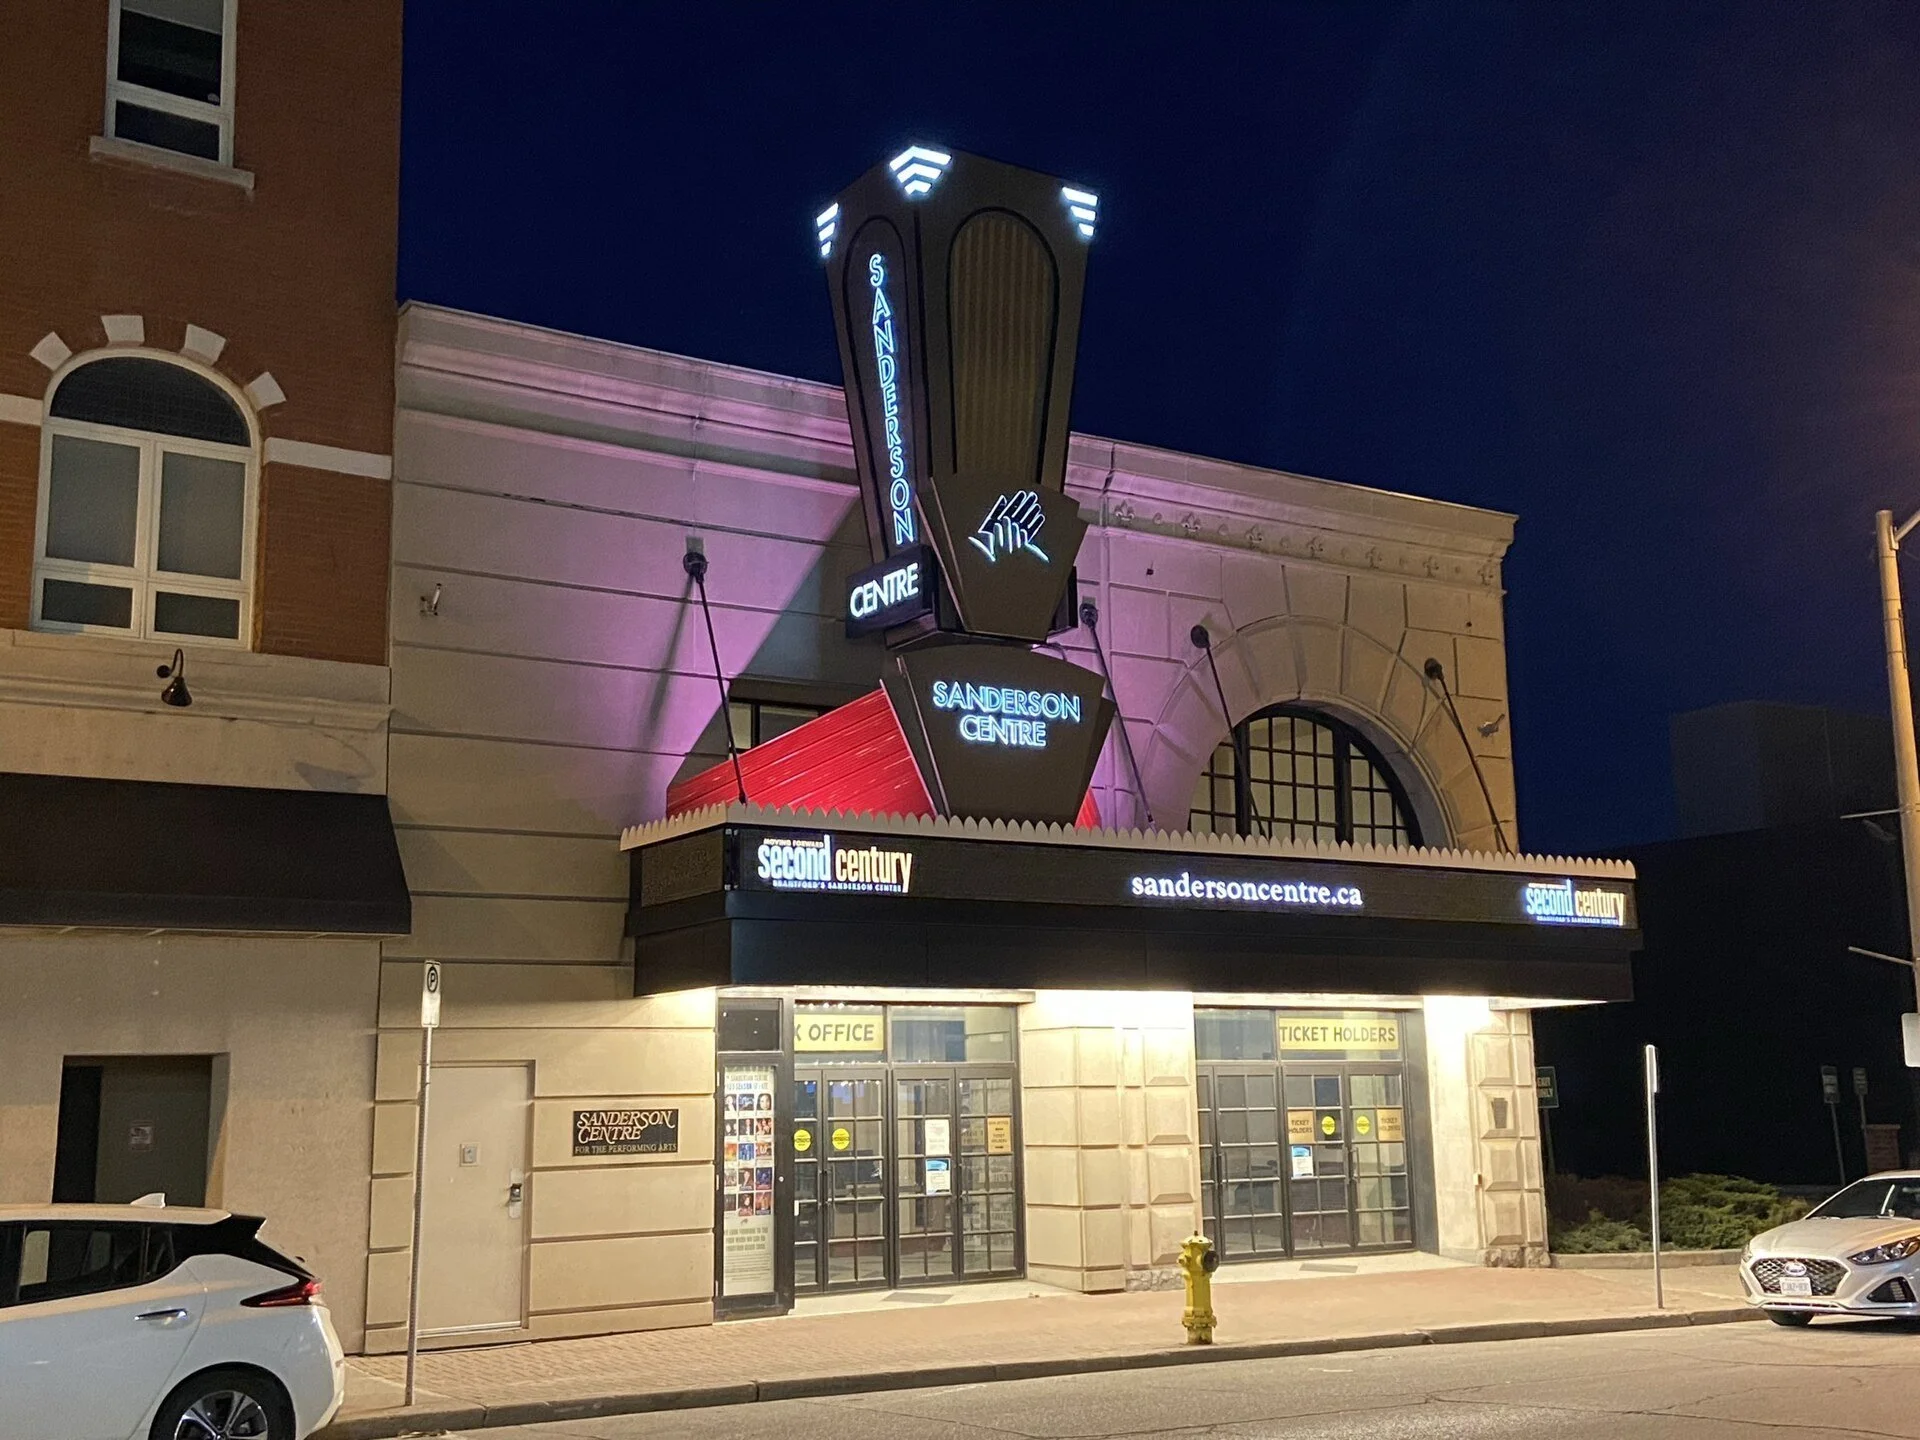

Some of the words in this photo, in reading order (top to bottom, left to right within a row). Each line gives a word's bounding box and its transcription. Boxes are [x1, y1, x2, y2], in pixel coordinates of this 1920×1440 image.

[868, 253, 915, 545] SANDERSON
[849, 562, 919, 618] CENTRE
[932, 680, 1081, 723] SANDERSON
[960, 714, 1047, 747] CENTRE
[757, 834, 832, 881] second
[835, 846, 913, 893] century
[1131, 872, 1364, 906] sandersoncentre.ca
[1525, 879, 1573, 917] second
[1574, 888, 1625, 926] century
[808, 1023, 875, 1042] OFFICE
[1280, 1026, 1329, 1042] TICKET
[1333, 1026, 1396, 1042] HOLDERS
[577, 1110, 675, 1130] SANDERSON
[578, 1126, 642, 1144] CENTRE
[575, 1145, 590, 1154] FOR
[592, 1145, 607, 1154] THE
[608, 1144, 657, 1153] PERFORMING
[658, 1143, 677, 1152] ARTS
